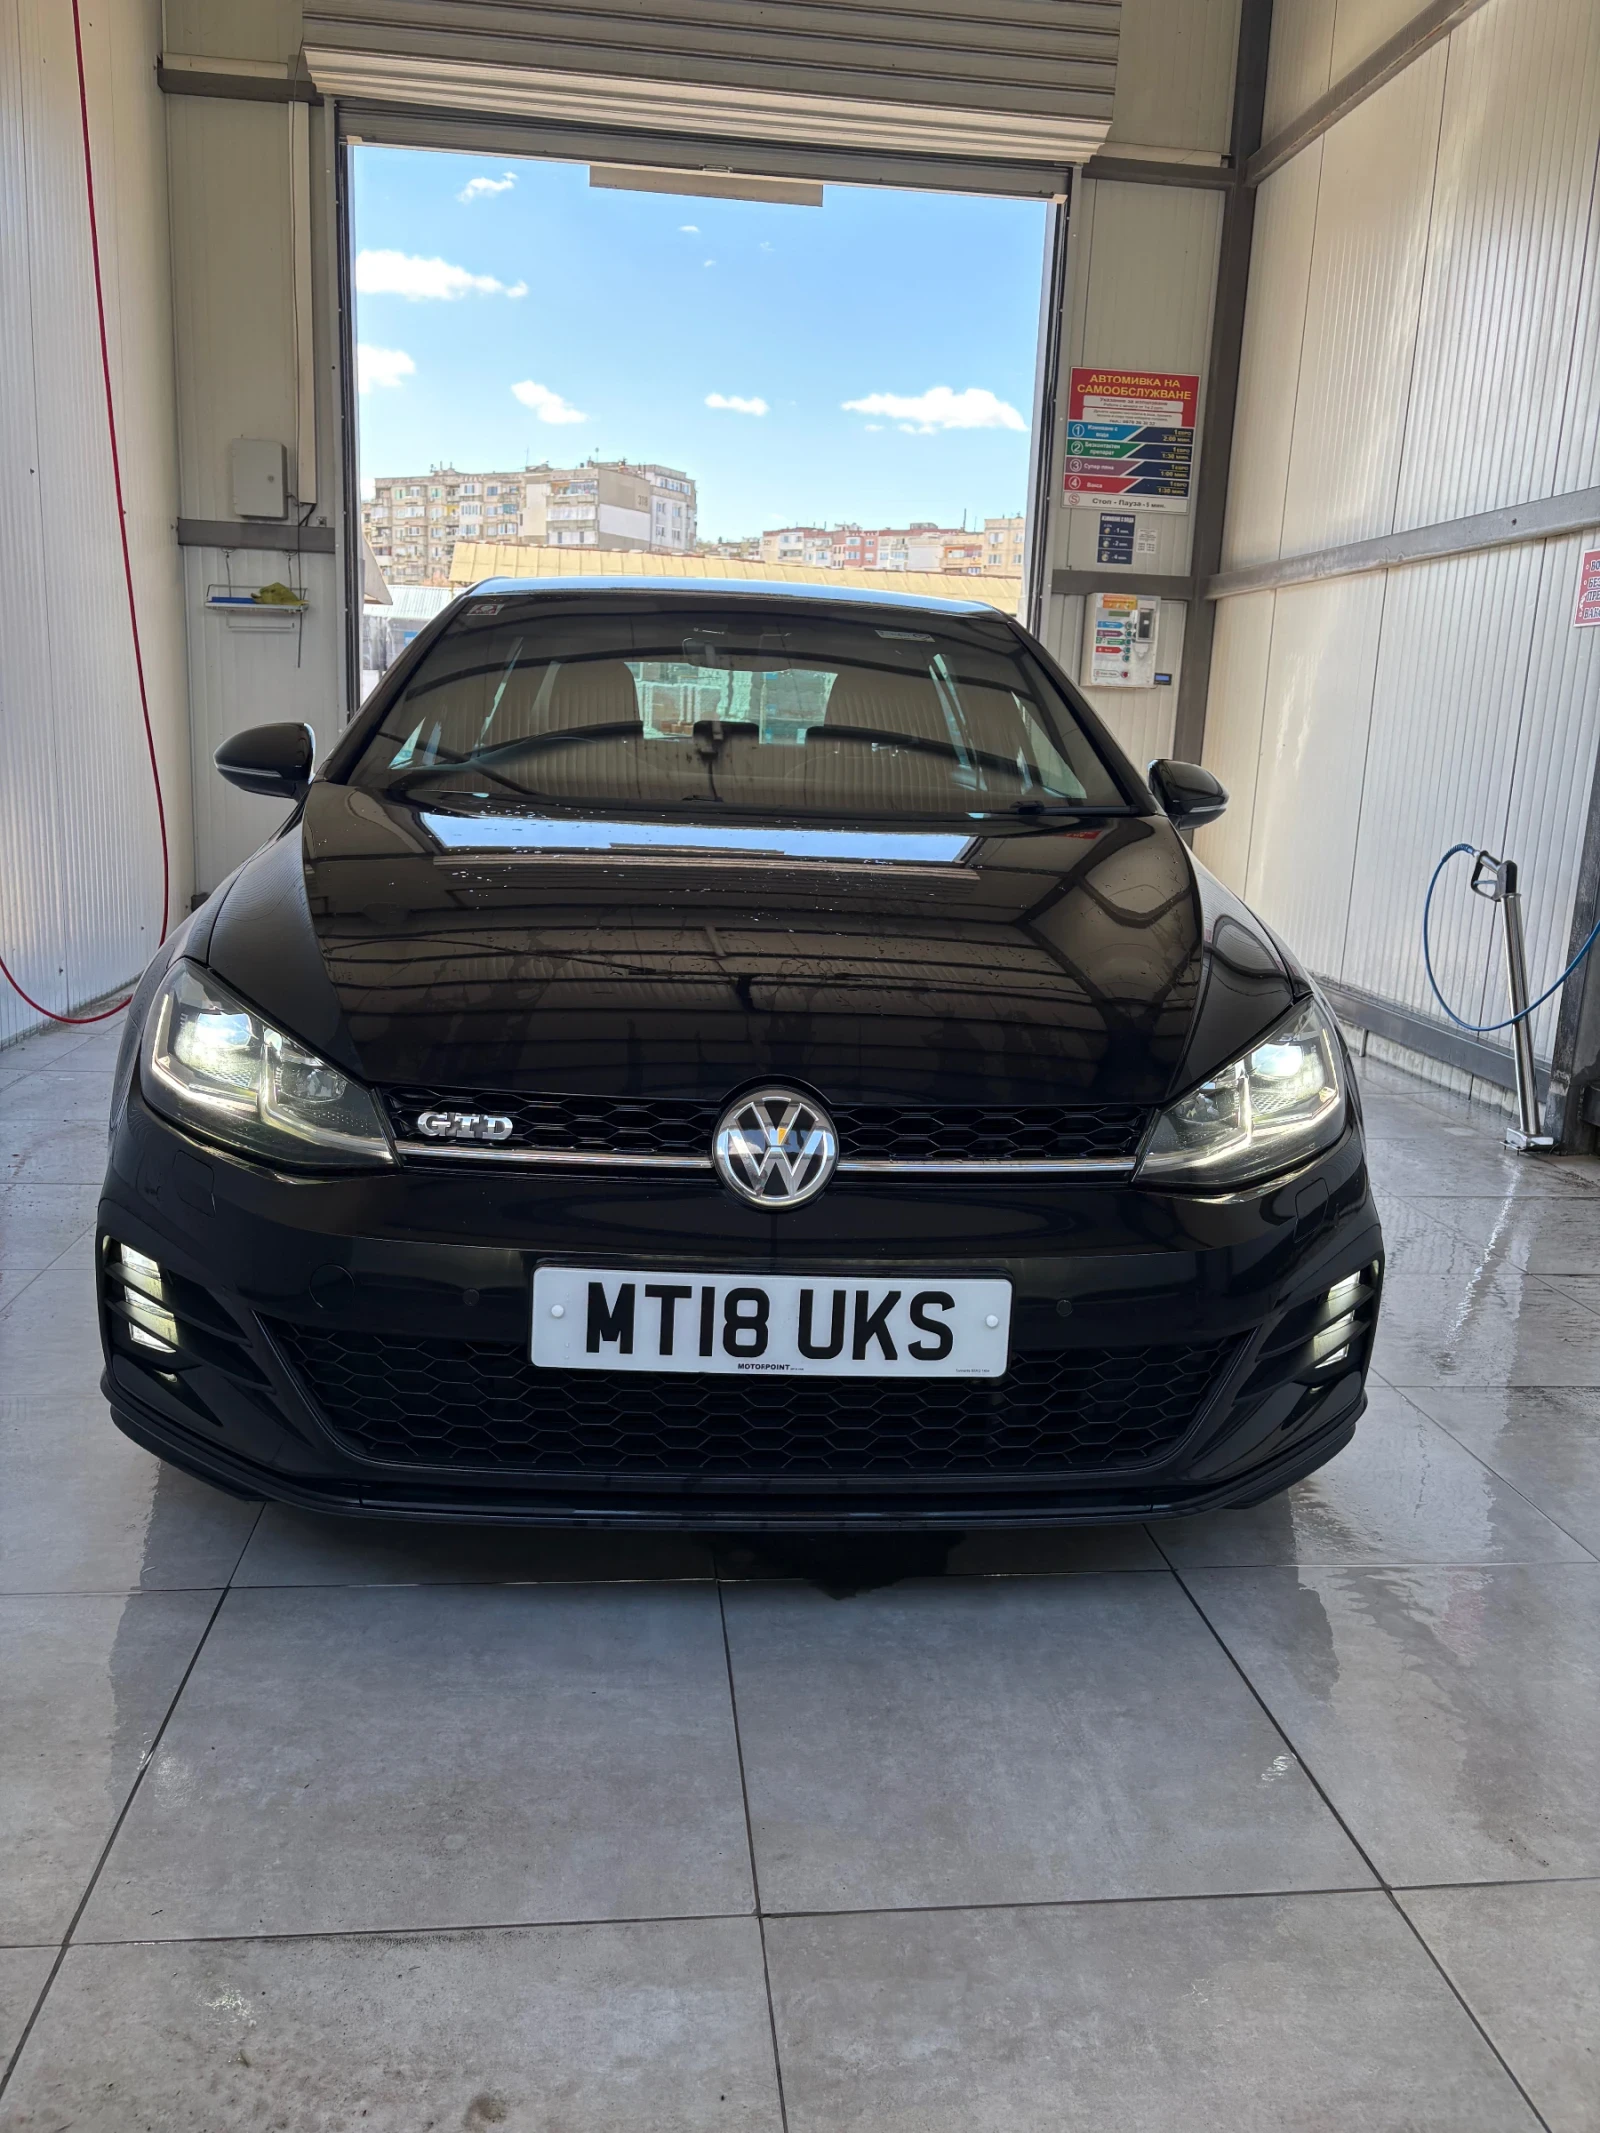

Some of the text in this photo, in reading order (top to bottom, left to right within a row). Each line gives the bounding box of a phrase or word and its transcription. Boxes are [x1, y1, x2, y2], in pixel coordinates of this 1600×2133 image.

[1090, 374, 1180, 388] АВТОМИВКА НА
[1077, 384, 1192, 400] САМООБСЛУЖВАНЕ
[1119, 499, 1141, 507] Пауза
[417, 1111, 514, 1140] GTD
[722, 1096, 828, 1199] VW
[586, 1281, 956, 1361] MT18 UKS
[738, 1362, 790, 1371] MOTORPOINT
